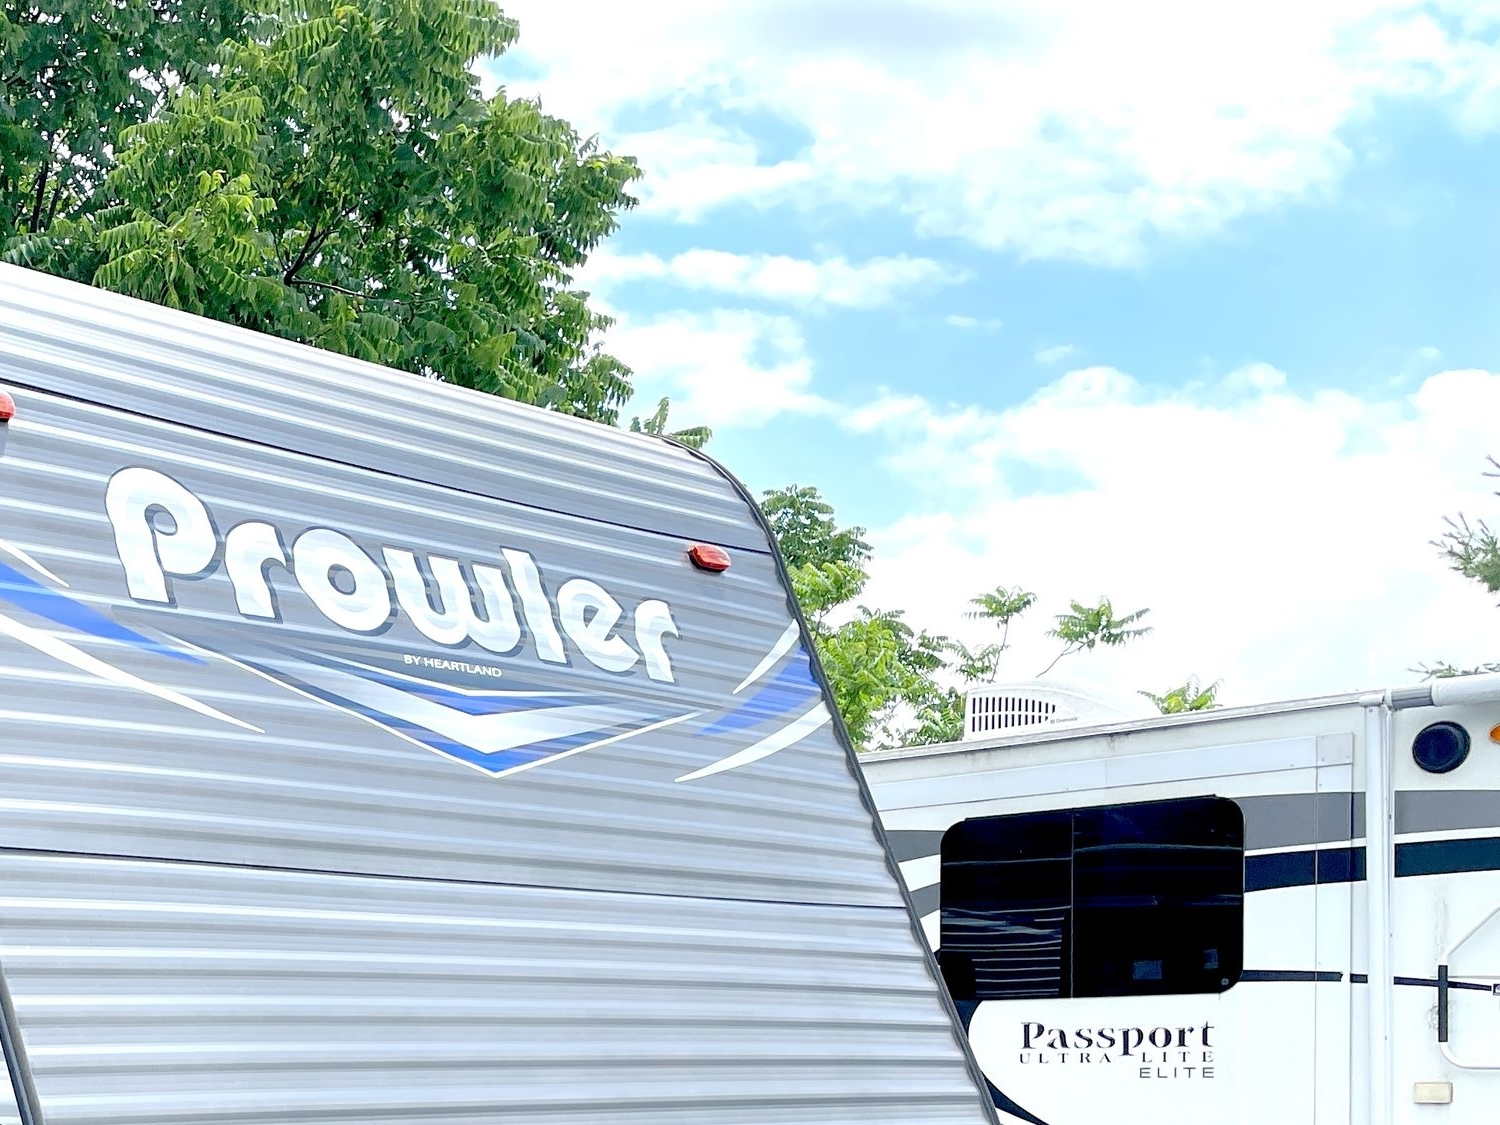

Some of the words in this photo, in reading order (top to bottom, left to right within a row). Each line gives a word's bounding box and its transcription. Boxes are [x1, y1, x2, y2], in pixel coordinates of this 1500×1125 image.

[105, 466, 681, 684] Prowler
[403, 654, 421, 666] BY
[423, 657, 503, 678] HEARTLAND
[1020, 1021, 1215, 1057] Passport
[1019, 1052, 1112, 1065] ULTRA
[1141, 1051, 1214, 1064] LITE
[1139, 1067, 1215, 1079] ELITE
